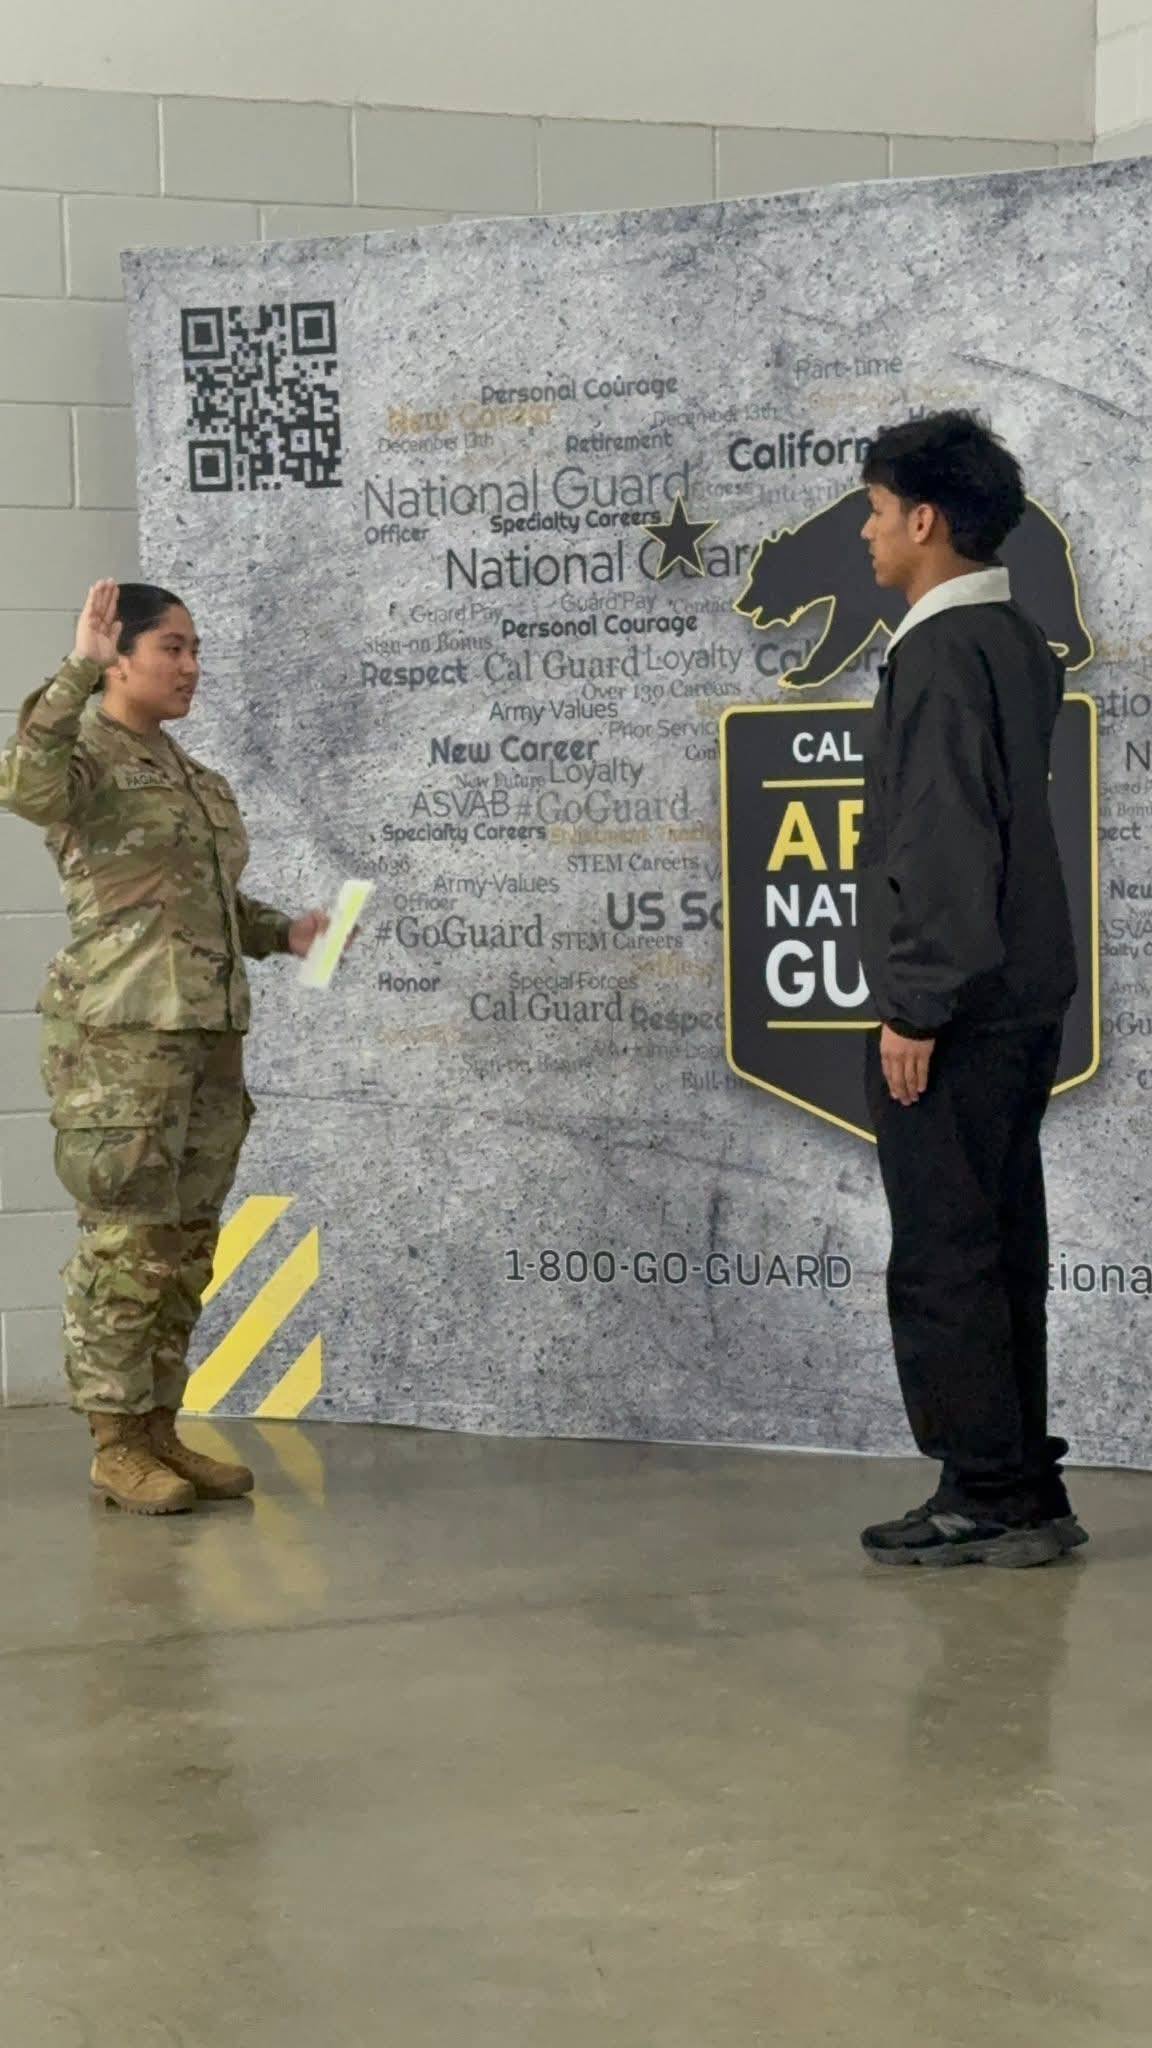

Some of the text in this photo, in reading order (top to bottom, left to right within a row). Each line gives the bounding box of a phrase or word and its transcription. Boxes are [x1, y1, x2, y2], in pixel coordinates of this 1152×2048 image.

[481, 375, 678, 404] Personal Courage
[378, 431, 495, 452] December 13th
[565, 430, 674, 453] Retirement
[728, 429, 873, 472] Californ
[364, 468, 538, 520] National
[552, 460, 690, 510] Guard
[364, 523, 430, 545] Officer
[489, 509, 662, 536] Specialty Careers
[446, 540, 623, 590] National
[410, 602, 502, 625] Guard Pay
[560, 591, 657, 615] Guard Pay
[502, 614, 698, 639] Personal Courage
[364, 632, 493, 657] Sign-on Bonus
[484, 644, 640, 682] Cal Guard
[645, 642, 744, 677] Loyalty
[360, 658, 469, 692] Respect
[581, 682, 630, 700] Over
[669, 680, 742, 698] Careers
[489, 699, 618, 726] Army Values
[607, 719, 718, 739] Prior Servic
[430, 735, 600, 765] New Career
[792, 731, 864, 763] CAL
[454, 774, 488, 789] New
[550, 757, 644, 789] Loyalty
[410, 786, 690, 825] ASVAB #GoGuard
[382, 823, 546, 844] Specialty Careers
[567, 852, 699, 873] STEM Careers
[393, 892, 457, 911] Officer
[607, 891, 666, 932] US
[766, 884, 857, 927] NAT
[375, 914, 543, 948] #GoGuard
[551, 931, 684, 951] STEM Careers
[378, 972, 441, 993] Honor
[509, 971, 638, 994] Special Forces
[766, 939, 870, 1008] GU
[470, 991, 624, 1022] Cal Guard
[630, 1000, 725, 1038] Respec
[504, 1249, 852, 1288] 1-800-GO-GUARD
